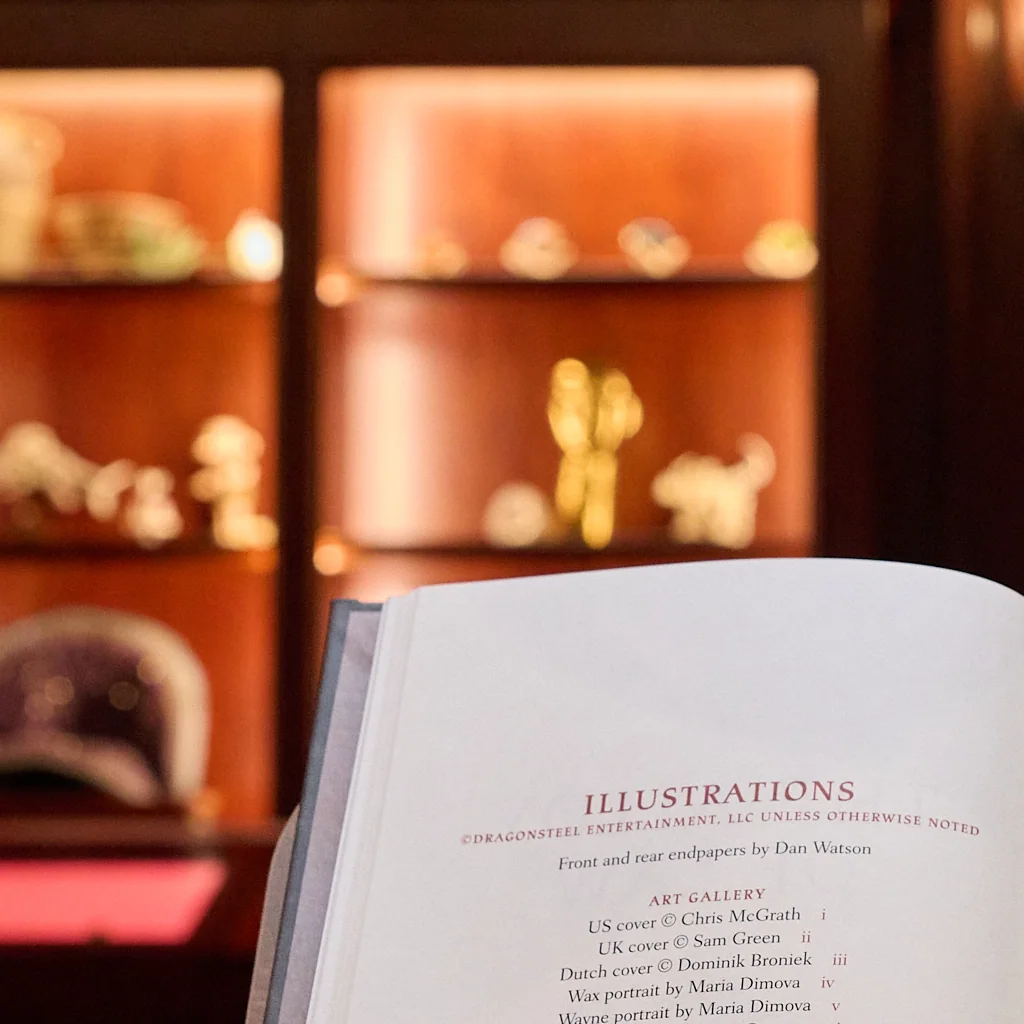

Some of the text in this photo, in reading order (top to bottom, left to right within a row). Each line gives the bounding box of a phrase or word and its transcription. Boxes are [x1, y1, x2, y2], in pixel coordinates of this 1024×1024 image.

[584, 780, 855, 816] ILLUSTRATIONS
[586, 814, 721, 835] ENTERTAINMENT,
[728, 812, 754, 824] LLC
[761, 810, 821, 822] UNLESS
[826, 811, 921, 826] OTHERWISE
[928, 817, 980, 836] NOTED
[558, 840, 872, 871] Front and rear endpapers by Dan Watson
[648, 888, 766, 907] ART GALLERY
[588, 918, 612, 934] US
[616, 919, 657, 932] cover
[681, 911, 723, 927] Chris
[728, 906, 801, 923] McGrath
[821, 908, 826, 921] i
[598, 940, 624, 956] UK
[628, 940, 670, 953] cover
[693, 933, 727, 948] Sam
[732, 931, 781, 946] Green
[801, 930, 811, 943] ii
[560, 963, 607, 982] Dutch
[612, 964, 654, 978] cover
[677, 953, 746, 972] Dominik
[750, 951, 813, 967] Broniek
[832, 953, 847, 966] iii
[568, 976, 835, 1005] Wax portrait by Maria Dimova iv
[675, 1003, 694, 1022] by
[698, 1001, 744, 1017] Maria
[750, 999, 812, 1014] Dimova
[831, 1002, 841, 1012] v
